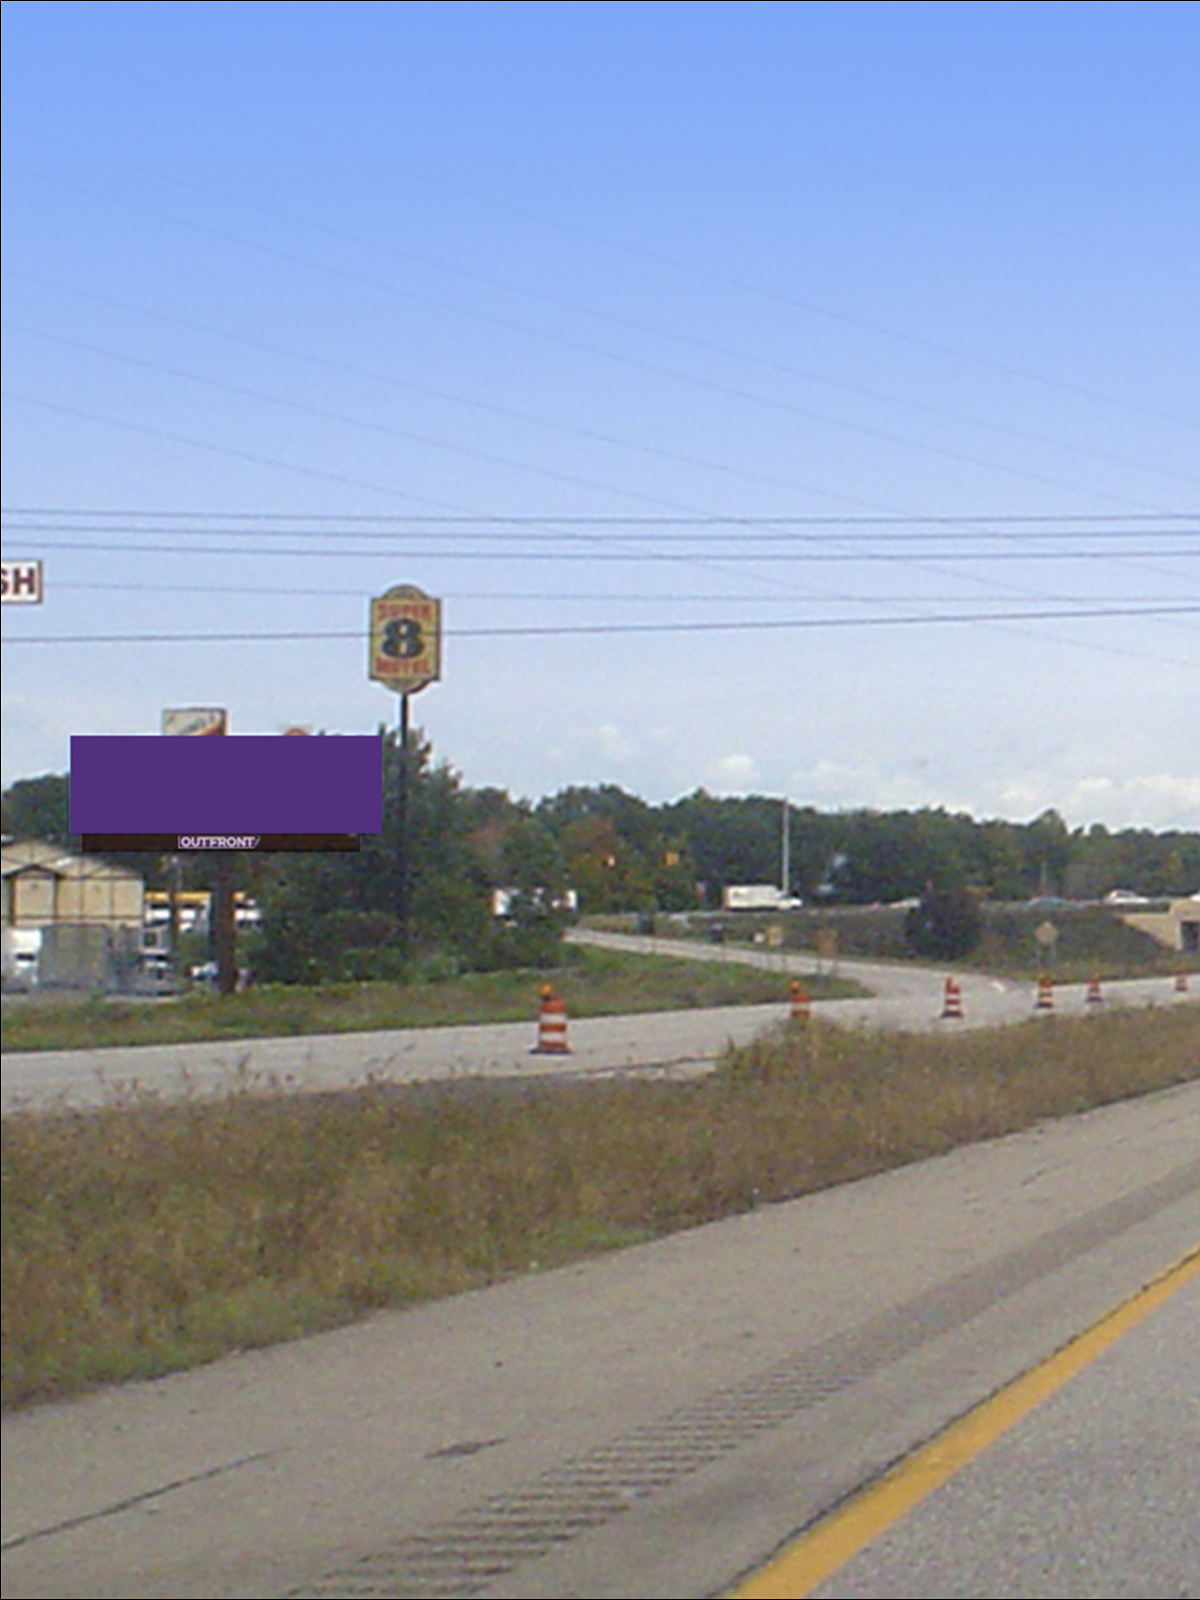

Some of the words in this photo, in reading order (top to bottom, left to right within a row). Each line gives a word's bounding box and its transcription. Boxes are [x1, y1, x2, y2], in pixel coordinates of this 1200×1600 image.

[377, 603, 432, 620] SUPER
[382, 618, 425, 658] 8
[376, 657, 430, 674] MOTEL
[180, 836, 255, 848] OUTFRONT
